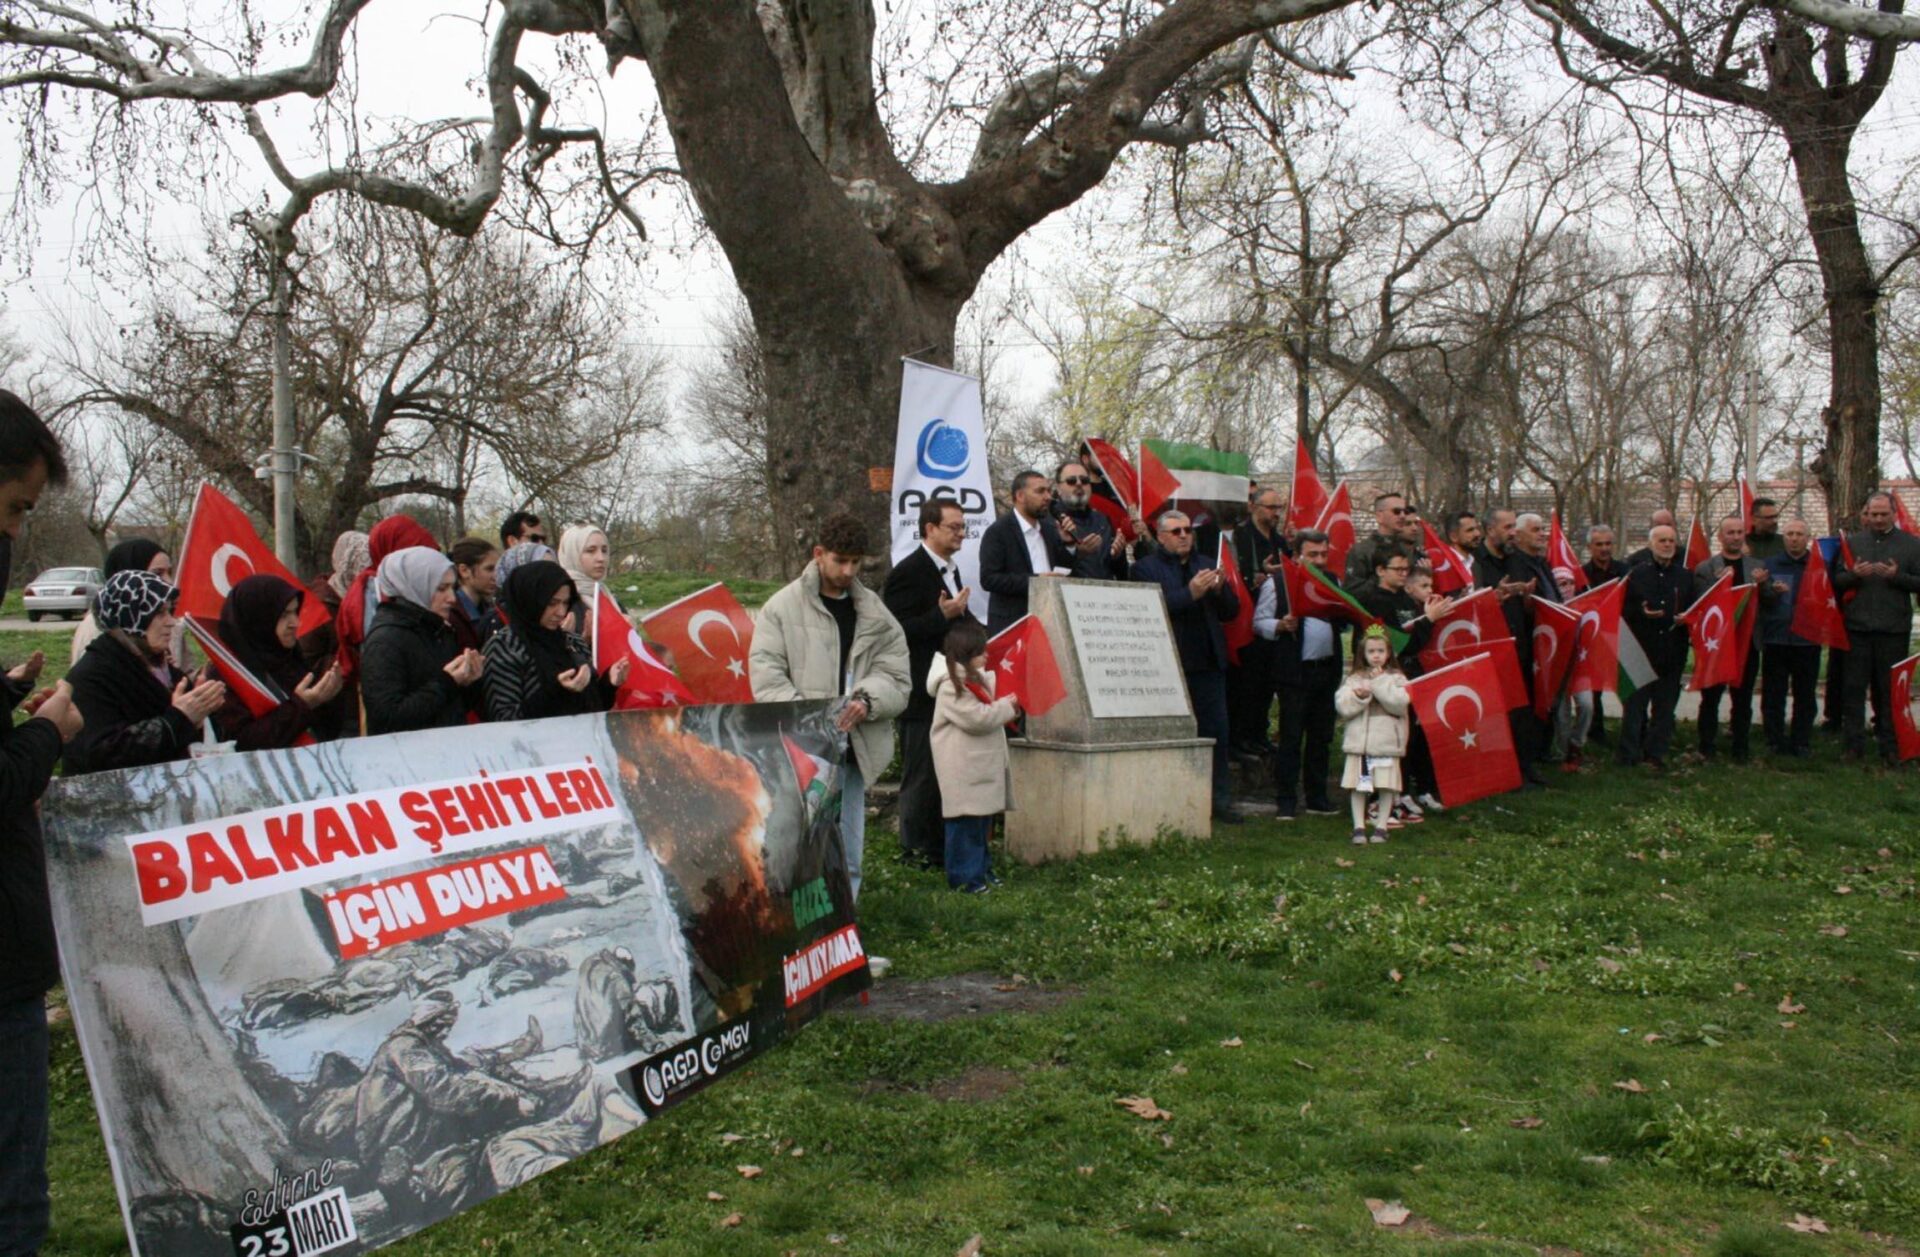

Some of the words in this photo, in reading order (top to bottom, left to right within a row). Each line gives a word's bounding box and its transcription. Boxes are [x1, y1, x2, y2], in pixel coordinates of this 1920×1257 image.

[132, 799, 398, 906] BALKAN
[399, 755, 615, 854] ŞEHİTLERİ
[326, 877, 427, 950] İÇİN
[426, 852, 562, 917] DUAYA
[783, 949, 811, 1004] İÇİN
[808, 929, 865, 983] KIYAMA
[661, 1048, 700, 1089] AGD
[720, 1021, 750, 1055] MGV
[239, 1226, 291, 1257] 23
[291, 1194, 350, 1255] MART
[240, 1158, 334, 1227] Edirne
